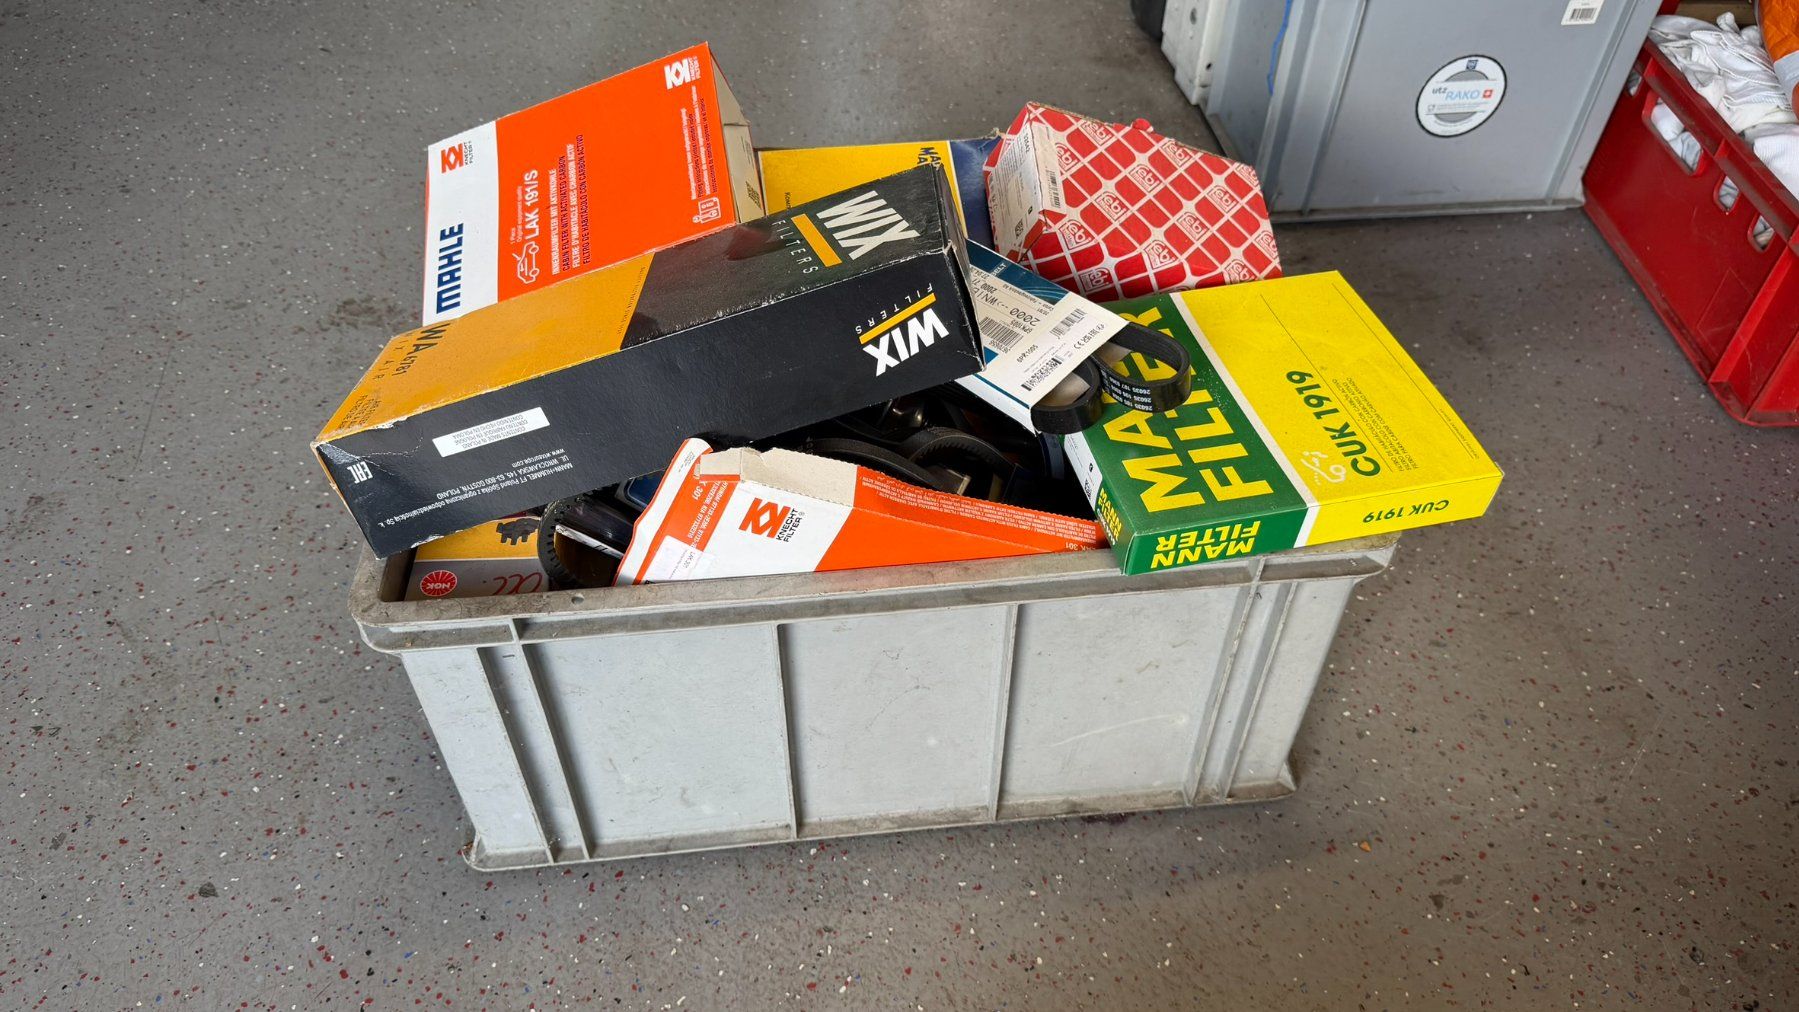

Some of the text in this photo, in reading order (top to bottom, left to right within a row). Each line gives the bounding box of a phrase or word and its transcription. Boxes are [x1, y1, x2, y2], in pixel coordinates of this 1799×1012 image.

[1445, 90, 1480, 100] RAKO
[524, 167, 539, 239] LAK 191/S
[816, 190, 921, 260] WIX
[436, 223, 464, 314] MAHLE
[772, 219, 818, 274] FILTERS
[855, 282, 932, 334] FILTERS
[1009, 305, 1039, 328] 2000
[862, 308, 950, 376] WIX
[1286, 370, 1340, 420] 1919
[1322, 422, 1380, 476] CUK
[776, 508, 798, 540] KNECHT
[783, 517, 802, 542] FILTER
[1100, 488, 1122, 532] MANN
[1156, 520, 1261, 544] FILTER
[1362, 500, 1449, 522] CUK 1919
[1066, 542, 1078, 550] 301
[1151, 537, 1256, 568] MANN
